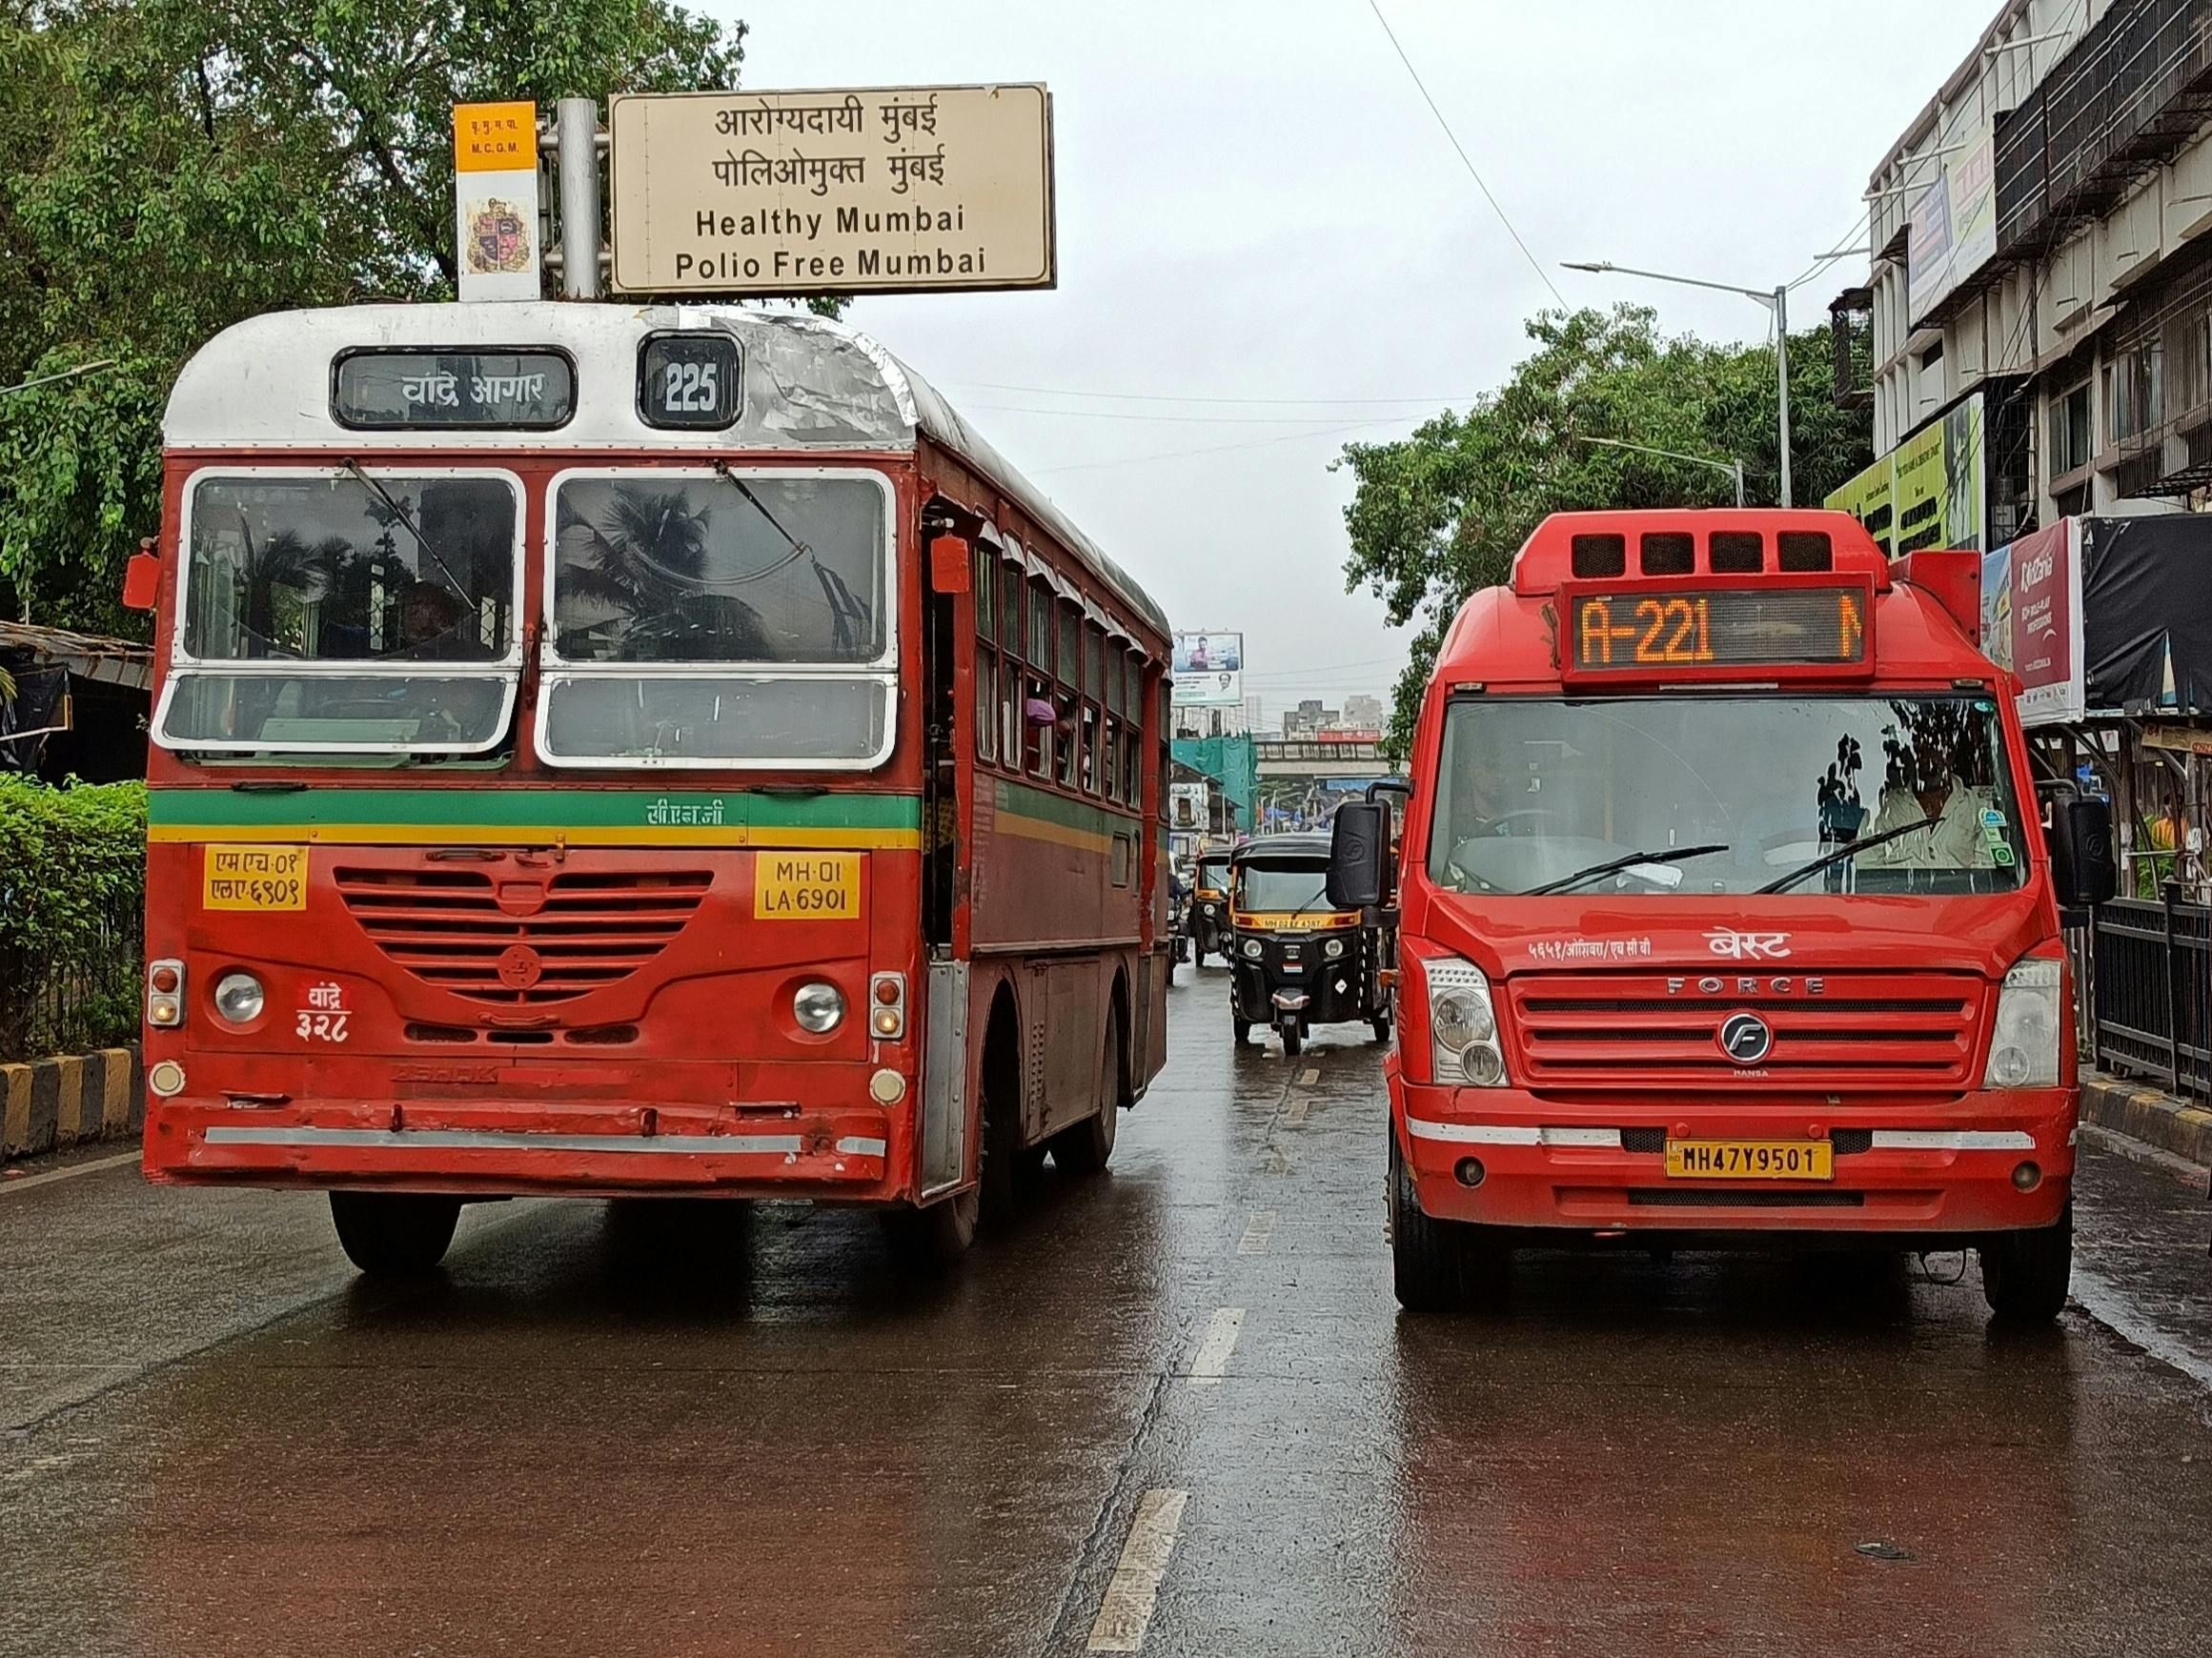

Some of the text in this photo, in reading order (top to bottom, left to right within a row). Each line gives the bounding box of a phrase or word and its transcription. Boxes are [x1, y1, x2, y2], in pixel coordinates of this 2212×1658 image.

[715, 93, 938, 143] आरोग्यदायी मुंबई
[712, 144, 945, 196] पोलिओमुक्त मुंबई
[696, 204, 964, 240] Healthy Mumbai
[676, 247, 985, 279] Polio Free Mumbai
[470, 373, 545, 403] आगार
[666, 362, 717, 411] 225
[1581, 599, 1713, 663] A-221
[1701, 926, 1792, 960] बेस्ट
[1668, 977, 1824, 994] FORCE
[295, 1013, 349, 1041] ३२८
[1683, 1147, 1814, 1171] MH47Y9501
